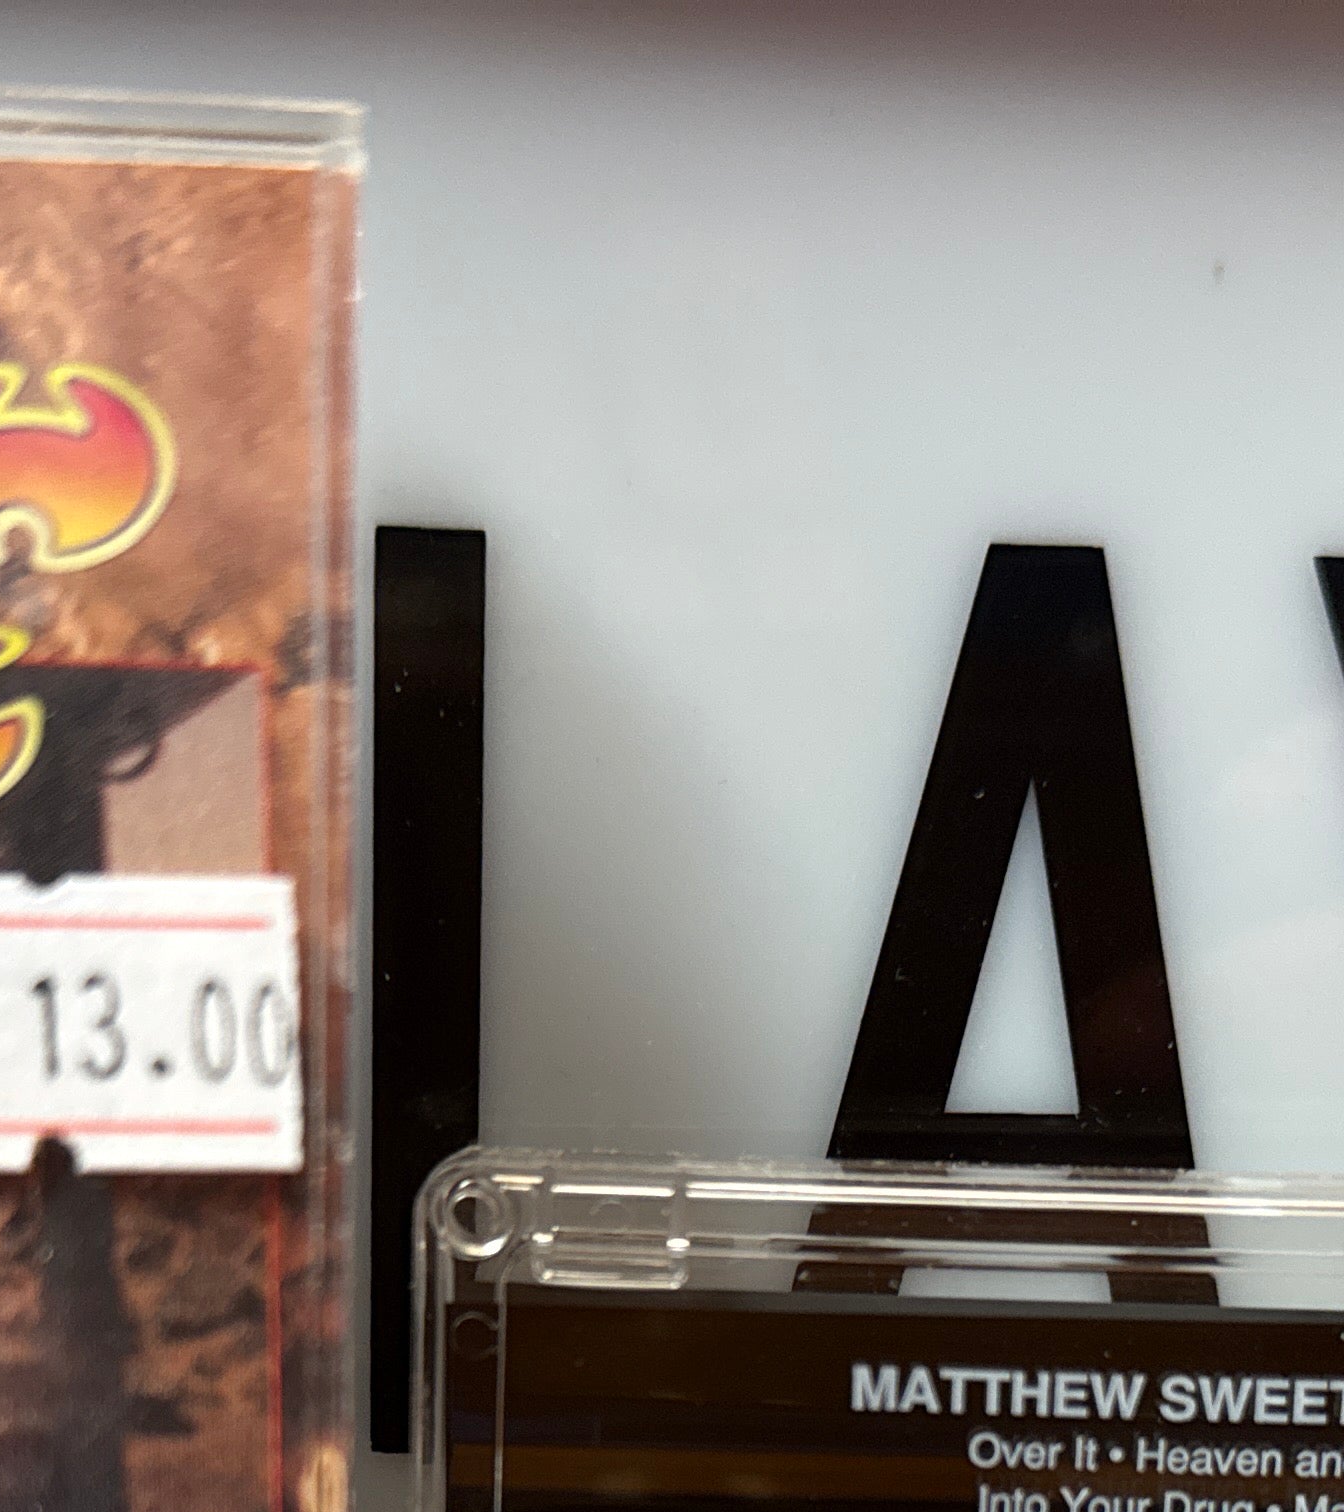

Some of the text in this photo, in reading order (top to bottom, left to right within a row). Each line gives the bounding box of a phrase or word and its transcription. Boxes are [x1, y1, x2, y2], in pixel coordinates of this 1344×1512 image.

[30, 974, 300, 1087] 13.00
[851, 1364, 1144, 1420] MATTHEW
[968, 1432, 1062, 1469] Over
[1073, 1437, 1099, 1471] It
[1136, 1439, 1282, 1476] Heaven
